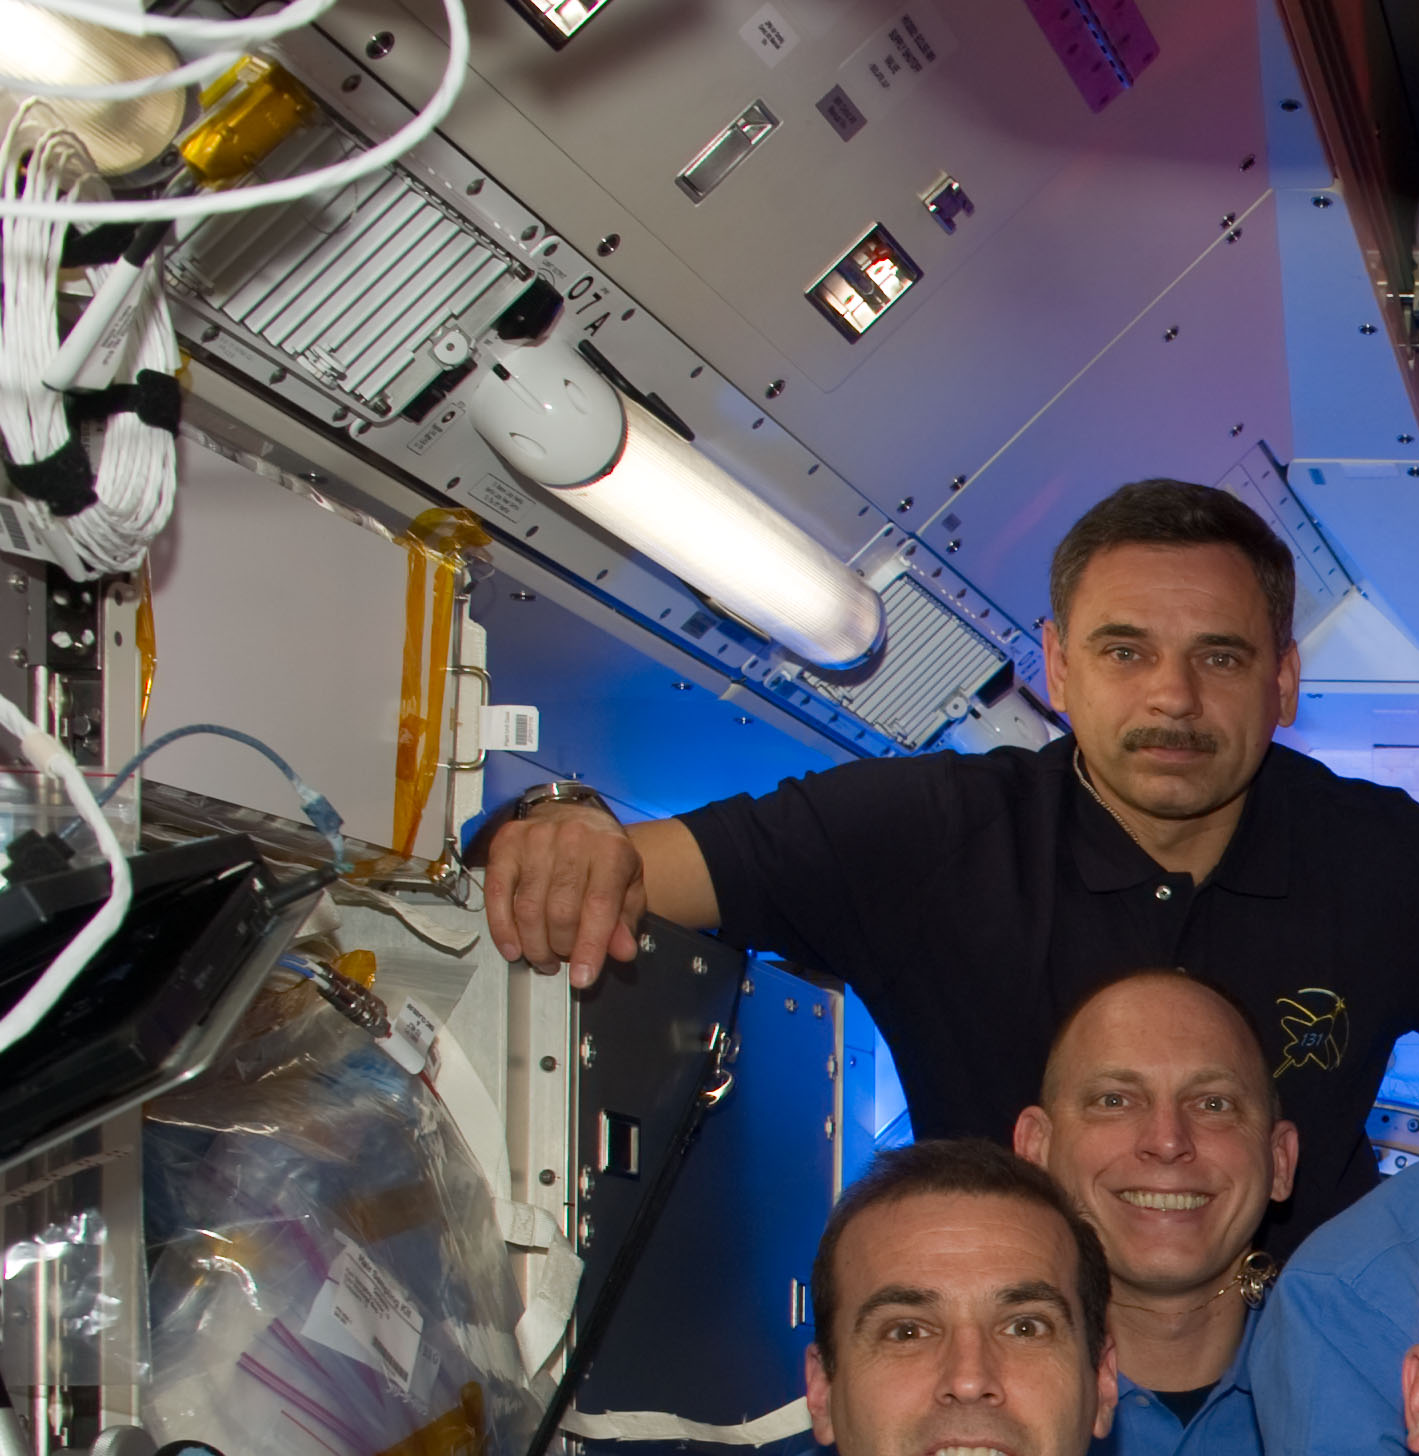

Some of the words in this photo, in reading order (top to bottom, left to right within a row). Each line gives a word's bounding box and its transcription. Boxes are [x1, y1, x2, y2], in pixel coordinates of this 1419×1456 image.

[568, 276, 611, 336] 07A
[1300, 1032, 1324, 1047] 131
[398, 1304, 412, 1318] Kit
